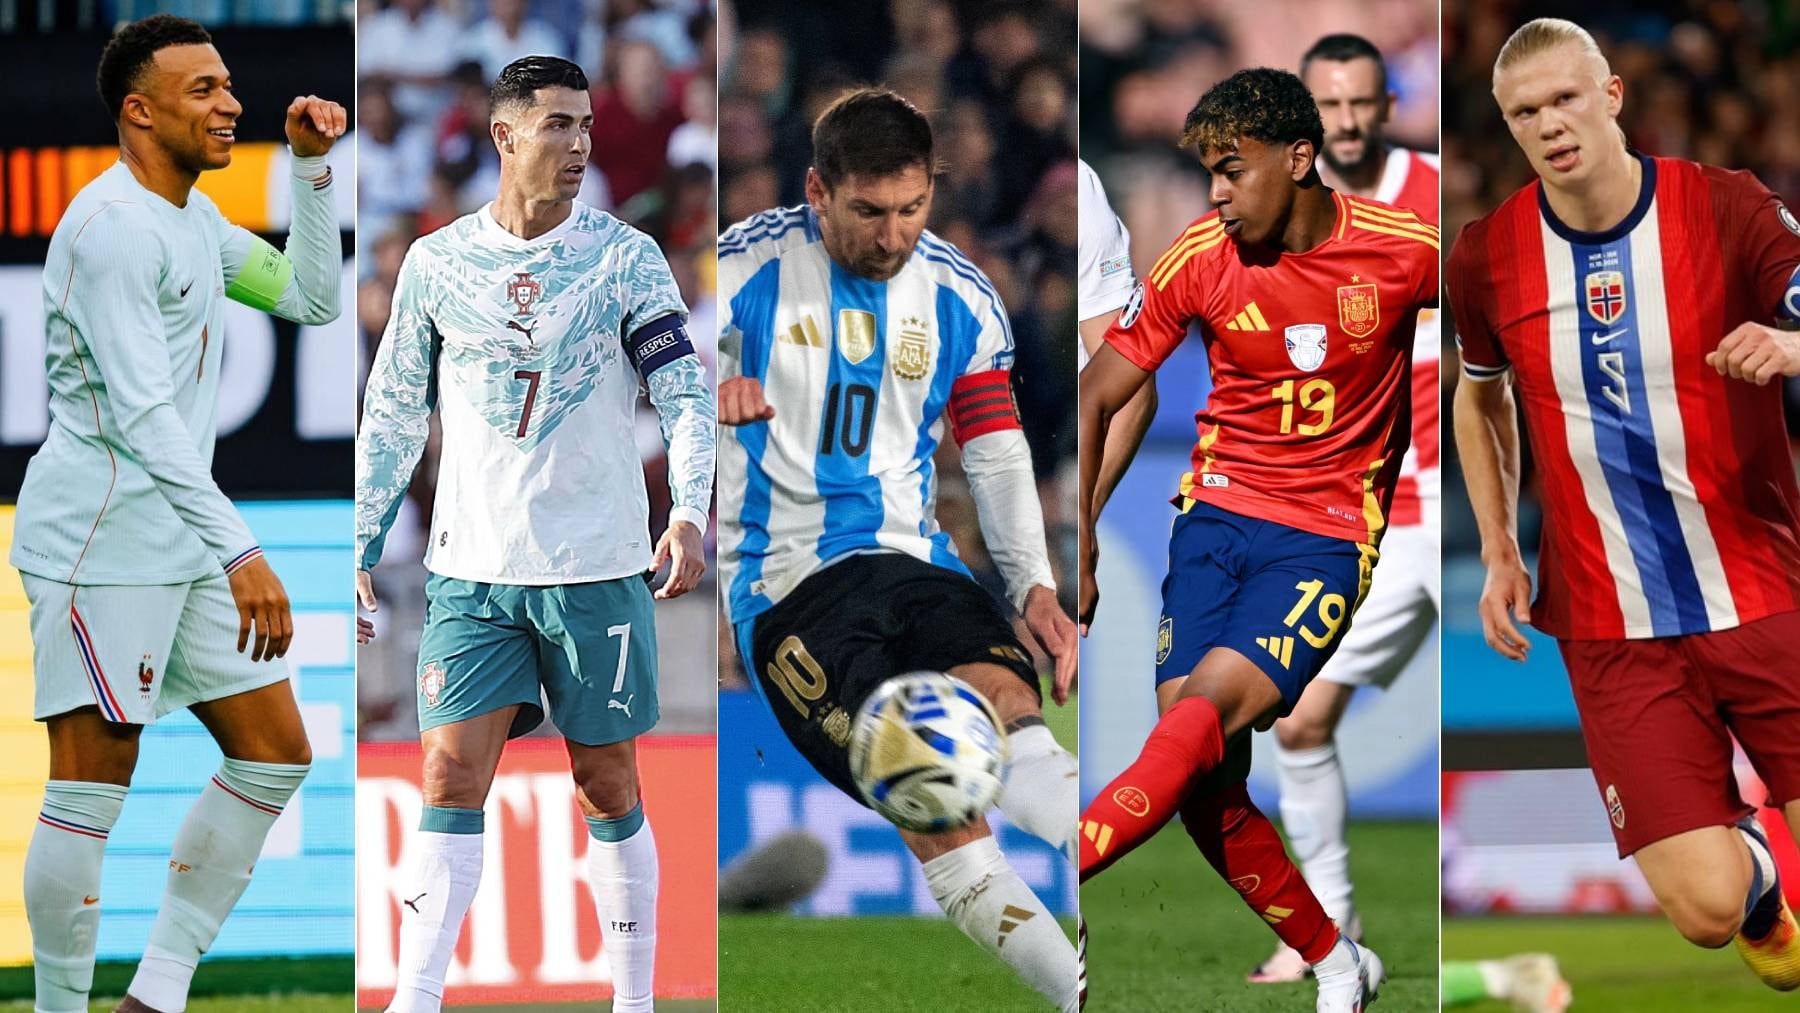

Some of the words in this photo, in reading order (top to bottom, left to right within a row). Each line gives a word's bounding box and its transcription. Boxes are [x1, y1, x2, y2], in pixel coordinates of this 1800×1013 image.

[638, 332, 676, 358] RESPECT
[514, 370, 542, 438] 7
[820, 383, 876, 458] 10
[1271, 379, 1336, 437] 19
[1283, 578, 1346, 649] 19
[607, 622, 632, 693] 7
[767, 635, 827, 720] 10
